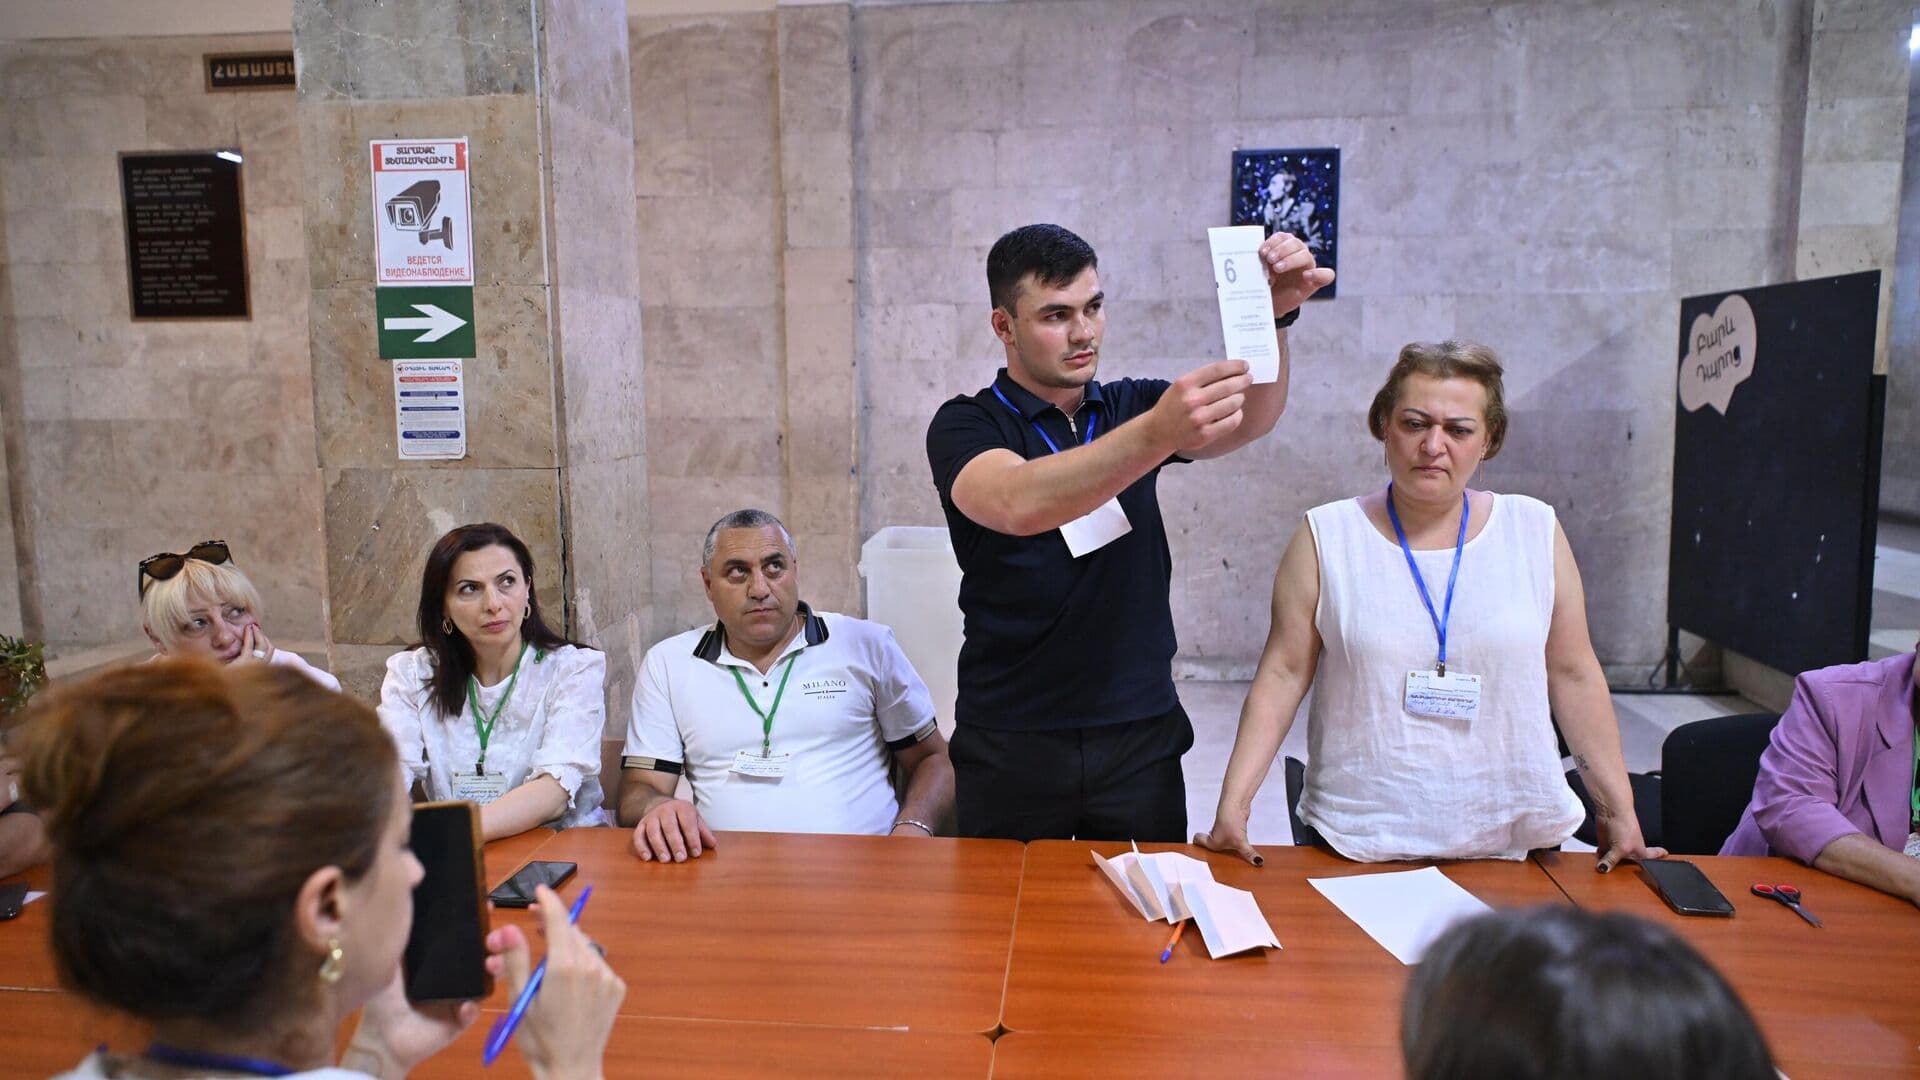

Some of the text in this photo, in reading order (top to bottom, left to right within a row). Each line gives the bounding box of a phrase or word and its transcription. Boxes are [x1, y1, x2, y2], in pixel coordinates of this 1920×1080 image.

[407, 255, 442, 266] ВЕДЕТСЯ
[385, 267, 465, 278] ВИДЕОНАБЛЮДЕНИЕ
[1224, 258, 1237, 284] 6
[802, 680, 846, 689] MILANO
